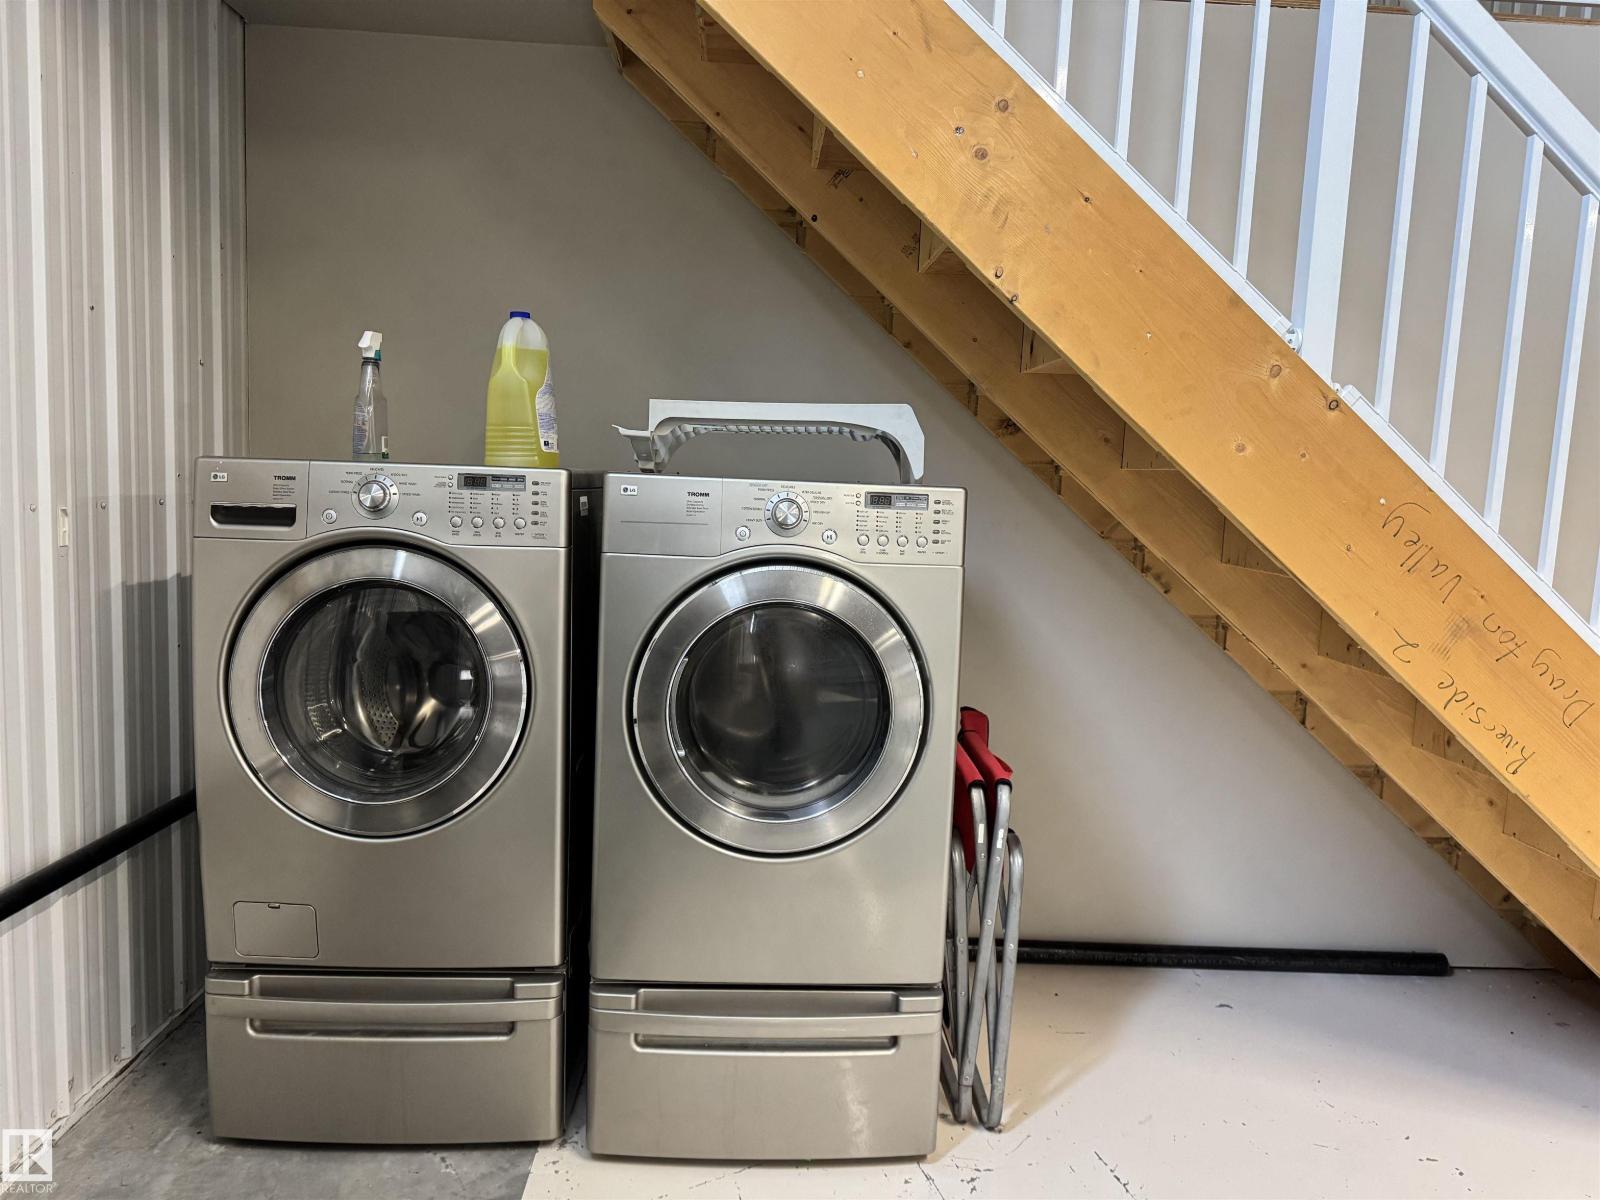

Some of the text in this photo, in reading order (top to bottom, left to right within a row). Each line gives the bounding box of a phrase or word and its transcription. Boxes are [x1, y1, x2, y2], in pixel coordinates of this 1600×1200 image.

[1382, 502, 1463, 604] Valley
[1393, 628, 1535, 775] Riverside 2
